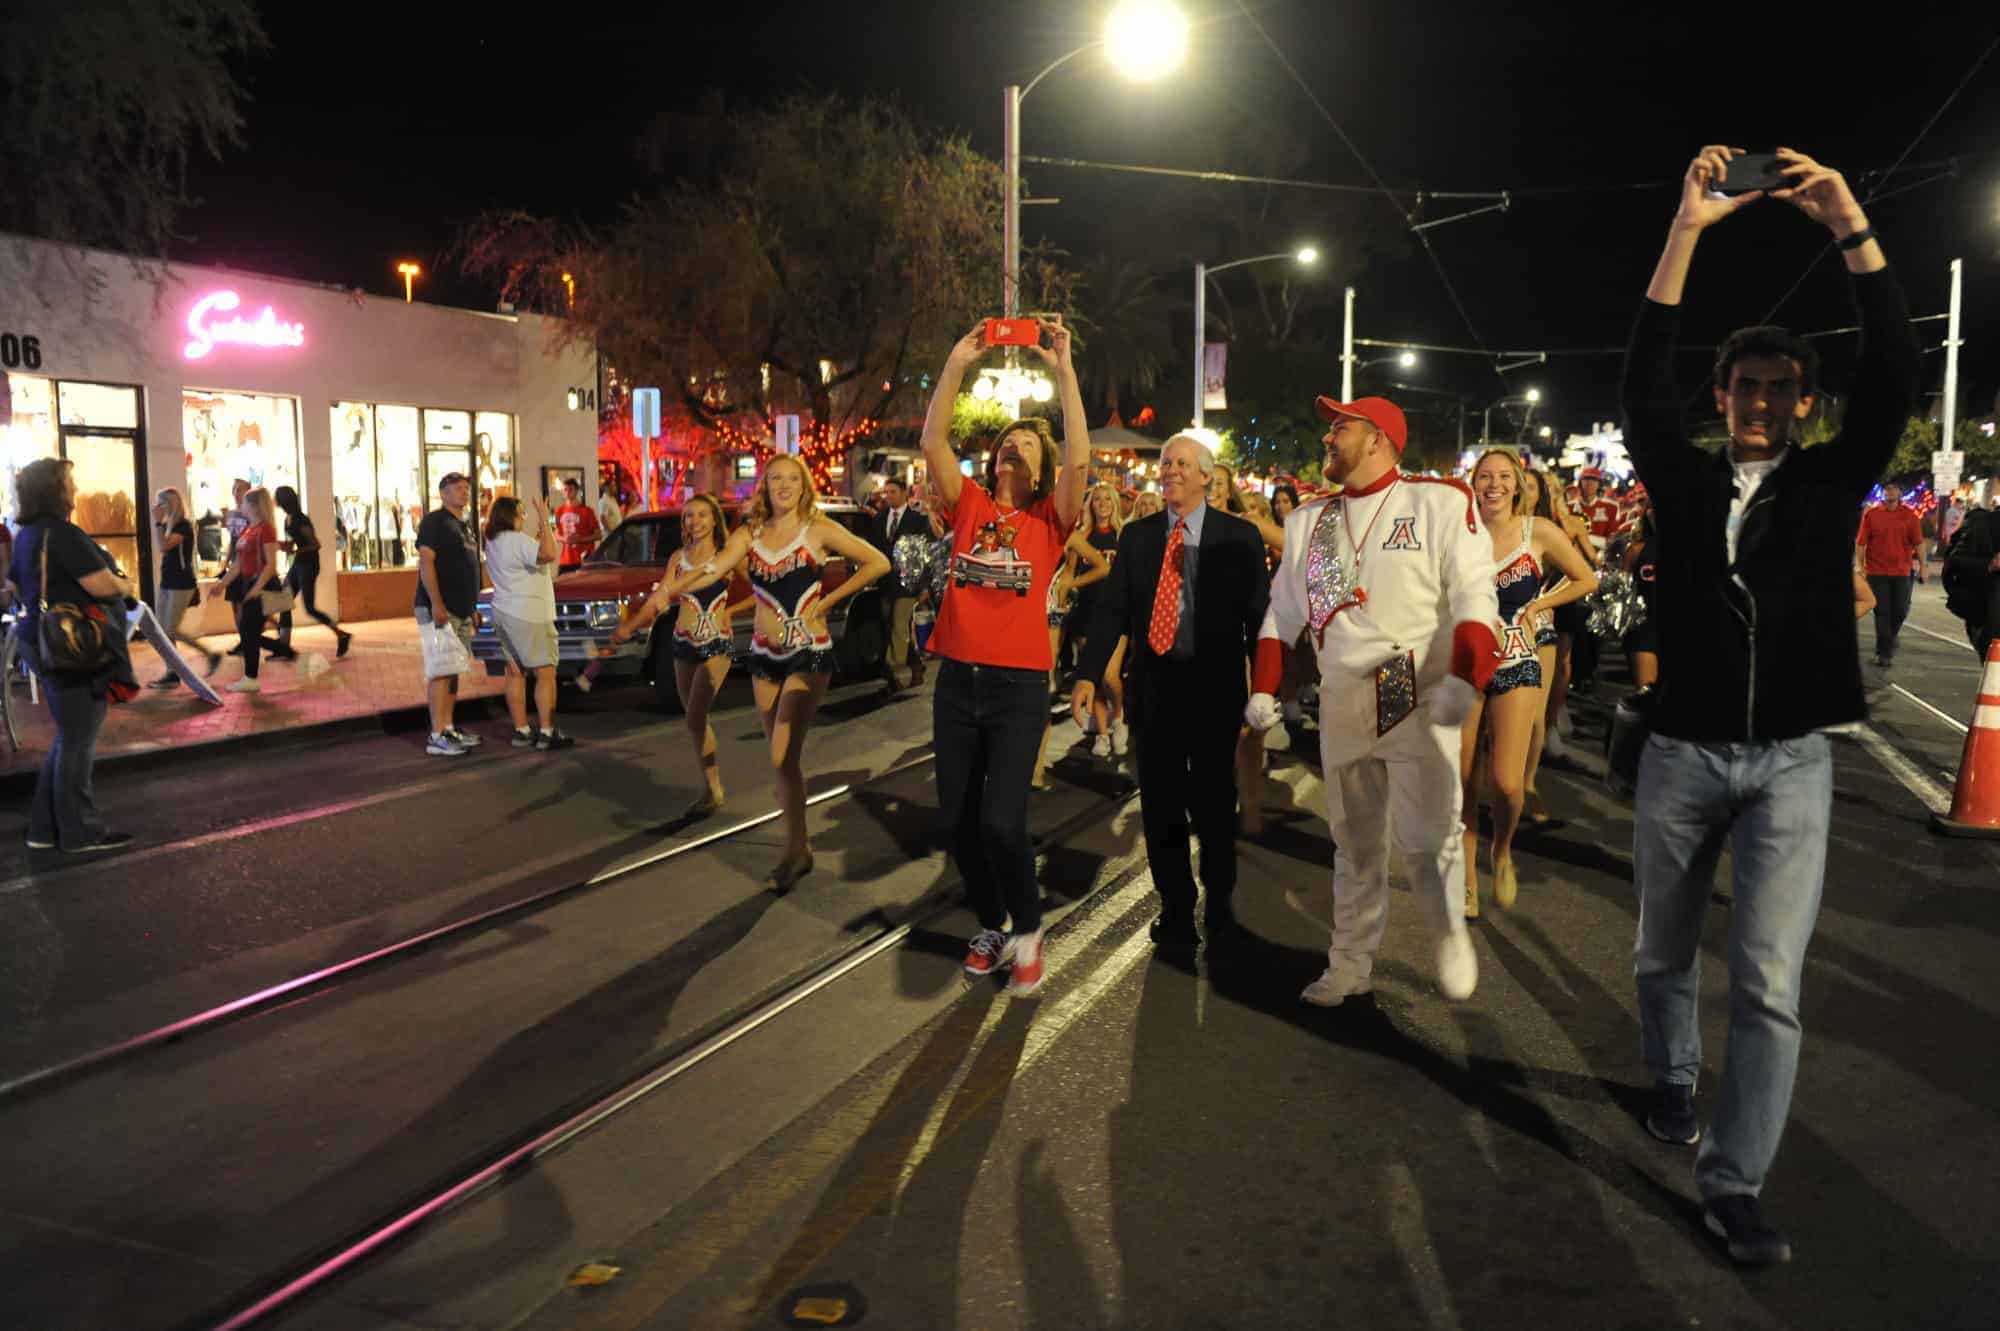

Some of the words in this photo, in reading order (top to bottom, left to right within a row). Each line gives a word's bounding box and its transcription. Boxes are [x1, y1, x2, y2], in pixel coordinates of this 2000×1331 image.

[567, 386, 594, 411] 04
[1382, 516, 1422, 551] A
[1503, 626, 1533, 660] A
